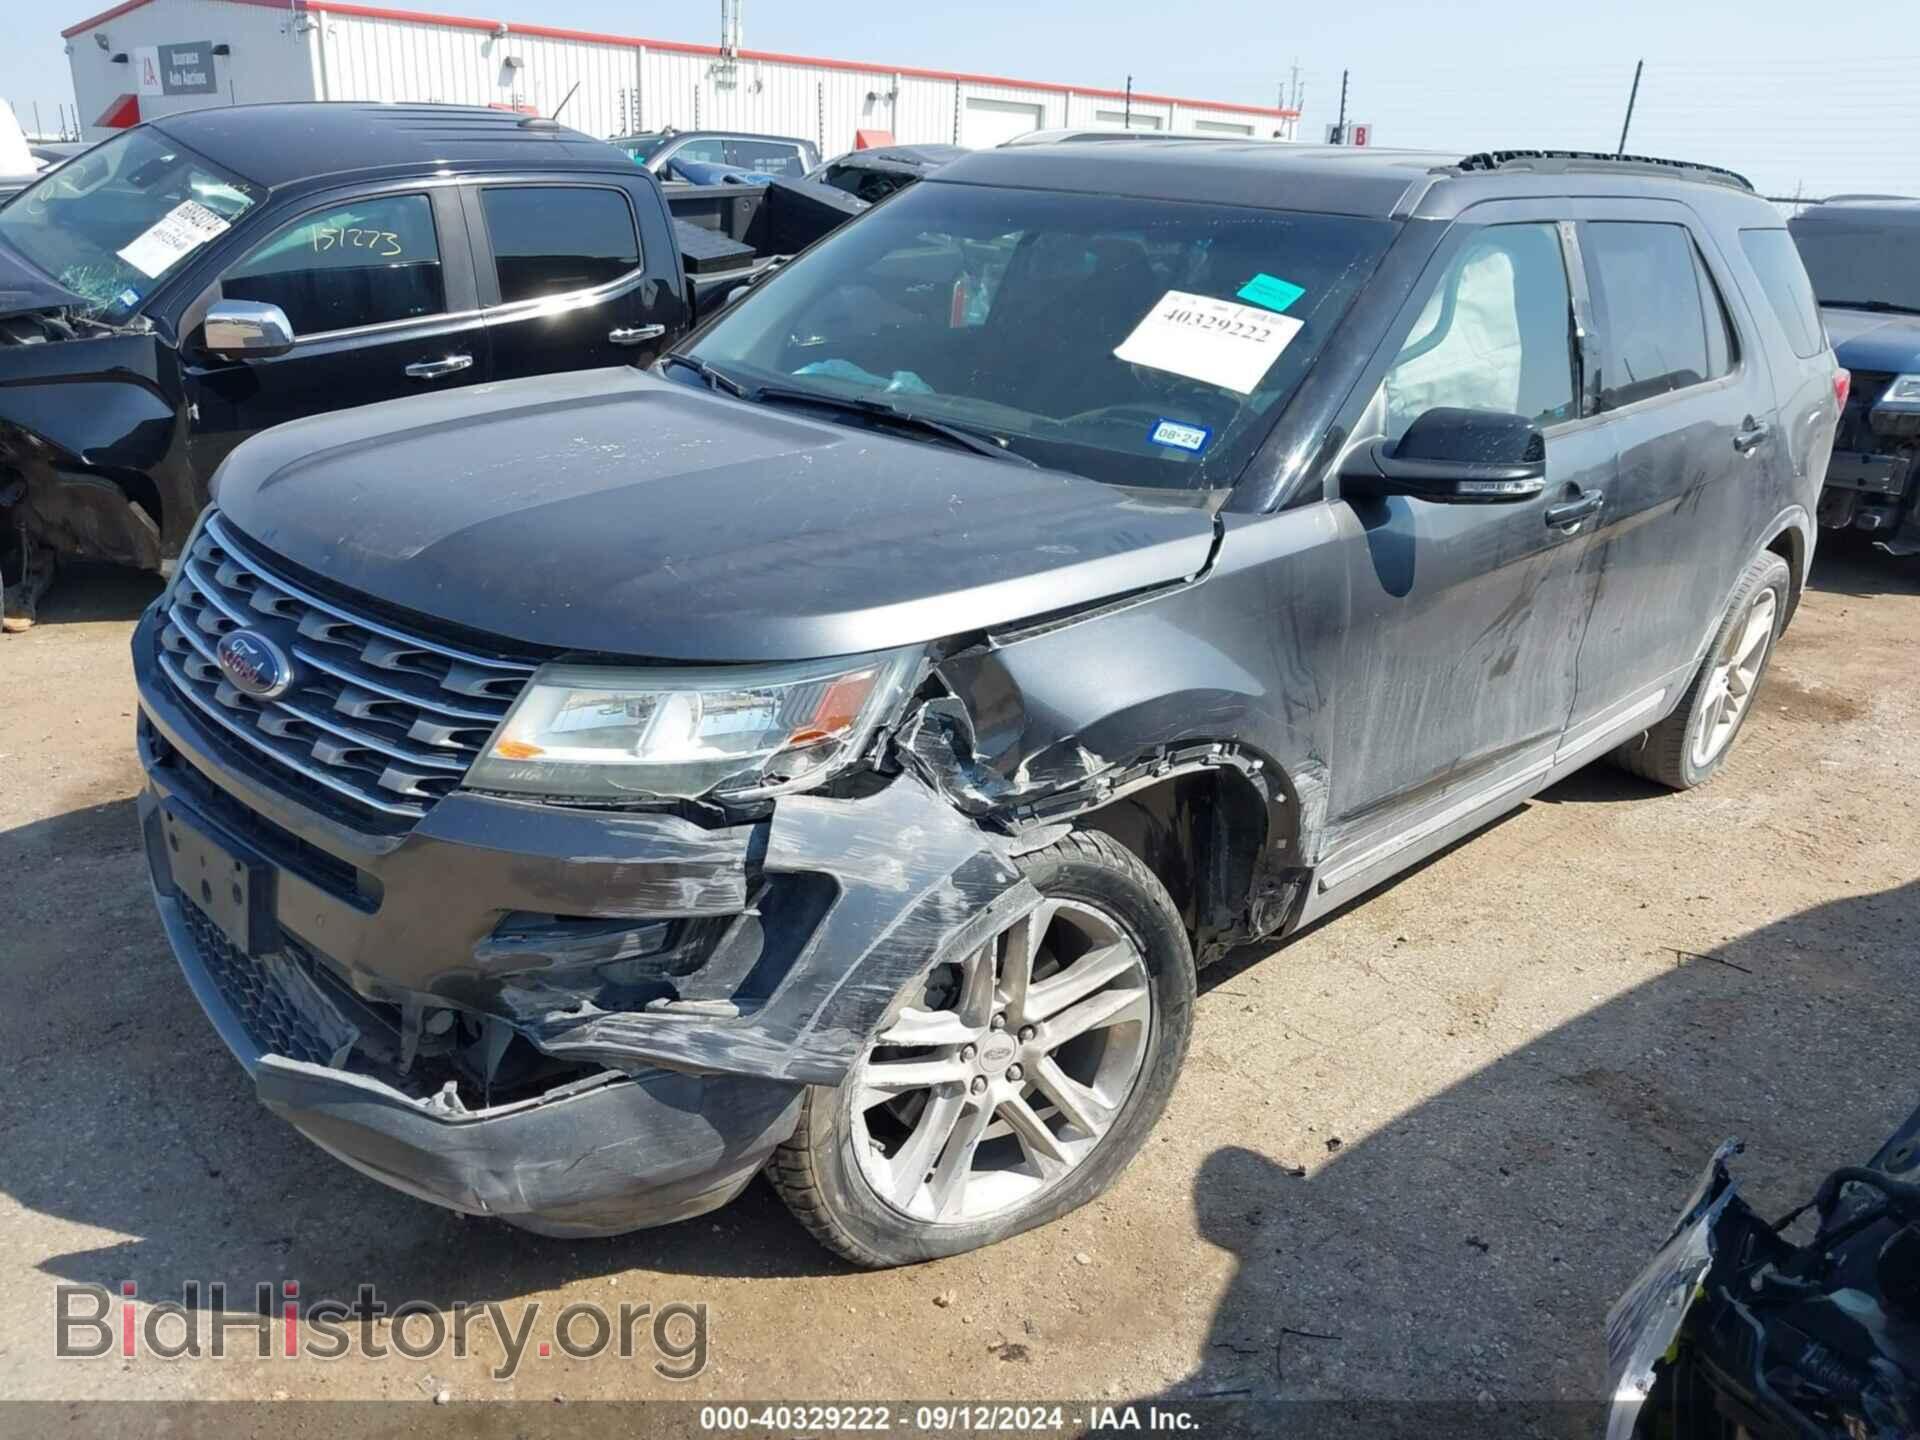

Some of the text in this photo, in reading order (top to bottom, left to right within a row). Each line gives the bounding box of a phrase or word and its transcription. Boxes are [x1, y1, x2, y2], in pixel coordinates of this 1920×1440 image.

[1355, 127, 1366, 146] B
[312, 225, 401, 256] 151273
[1163, 308, 1271, 343] 40329222
